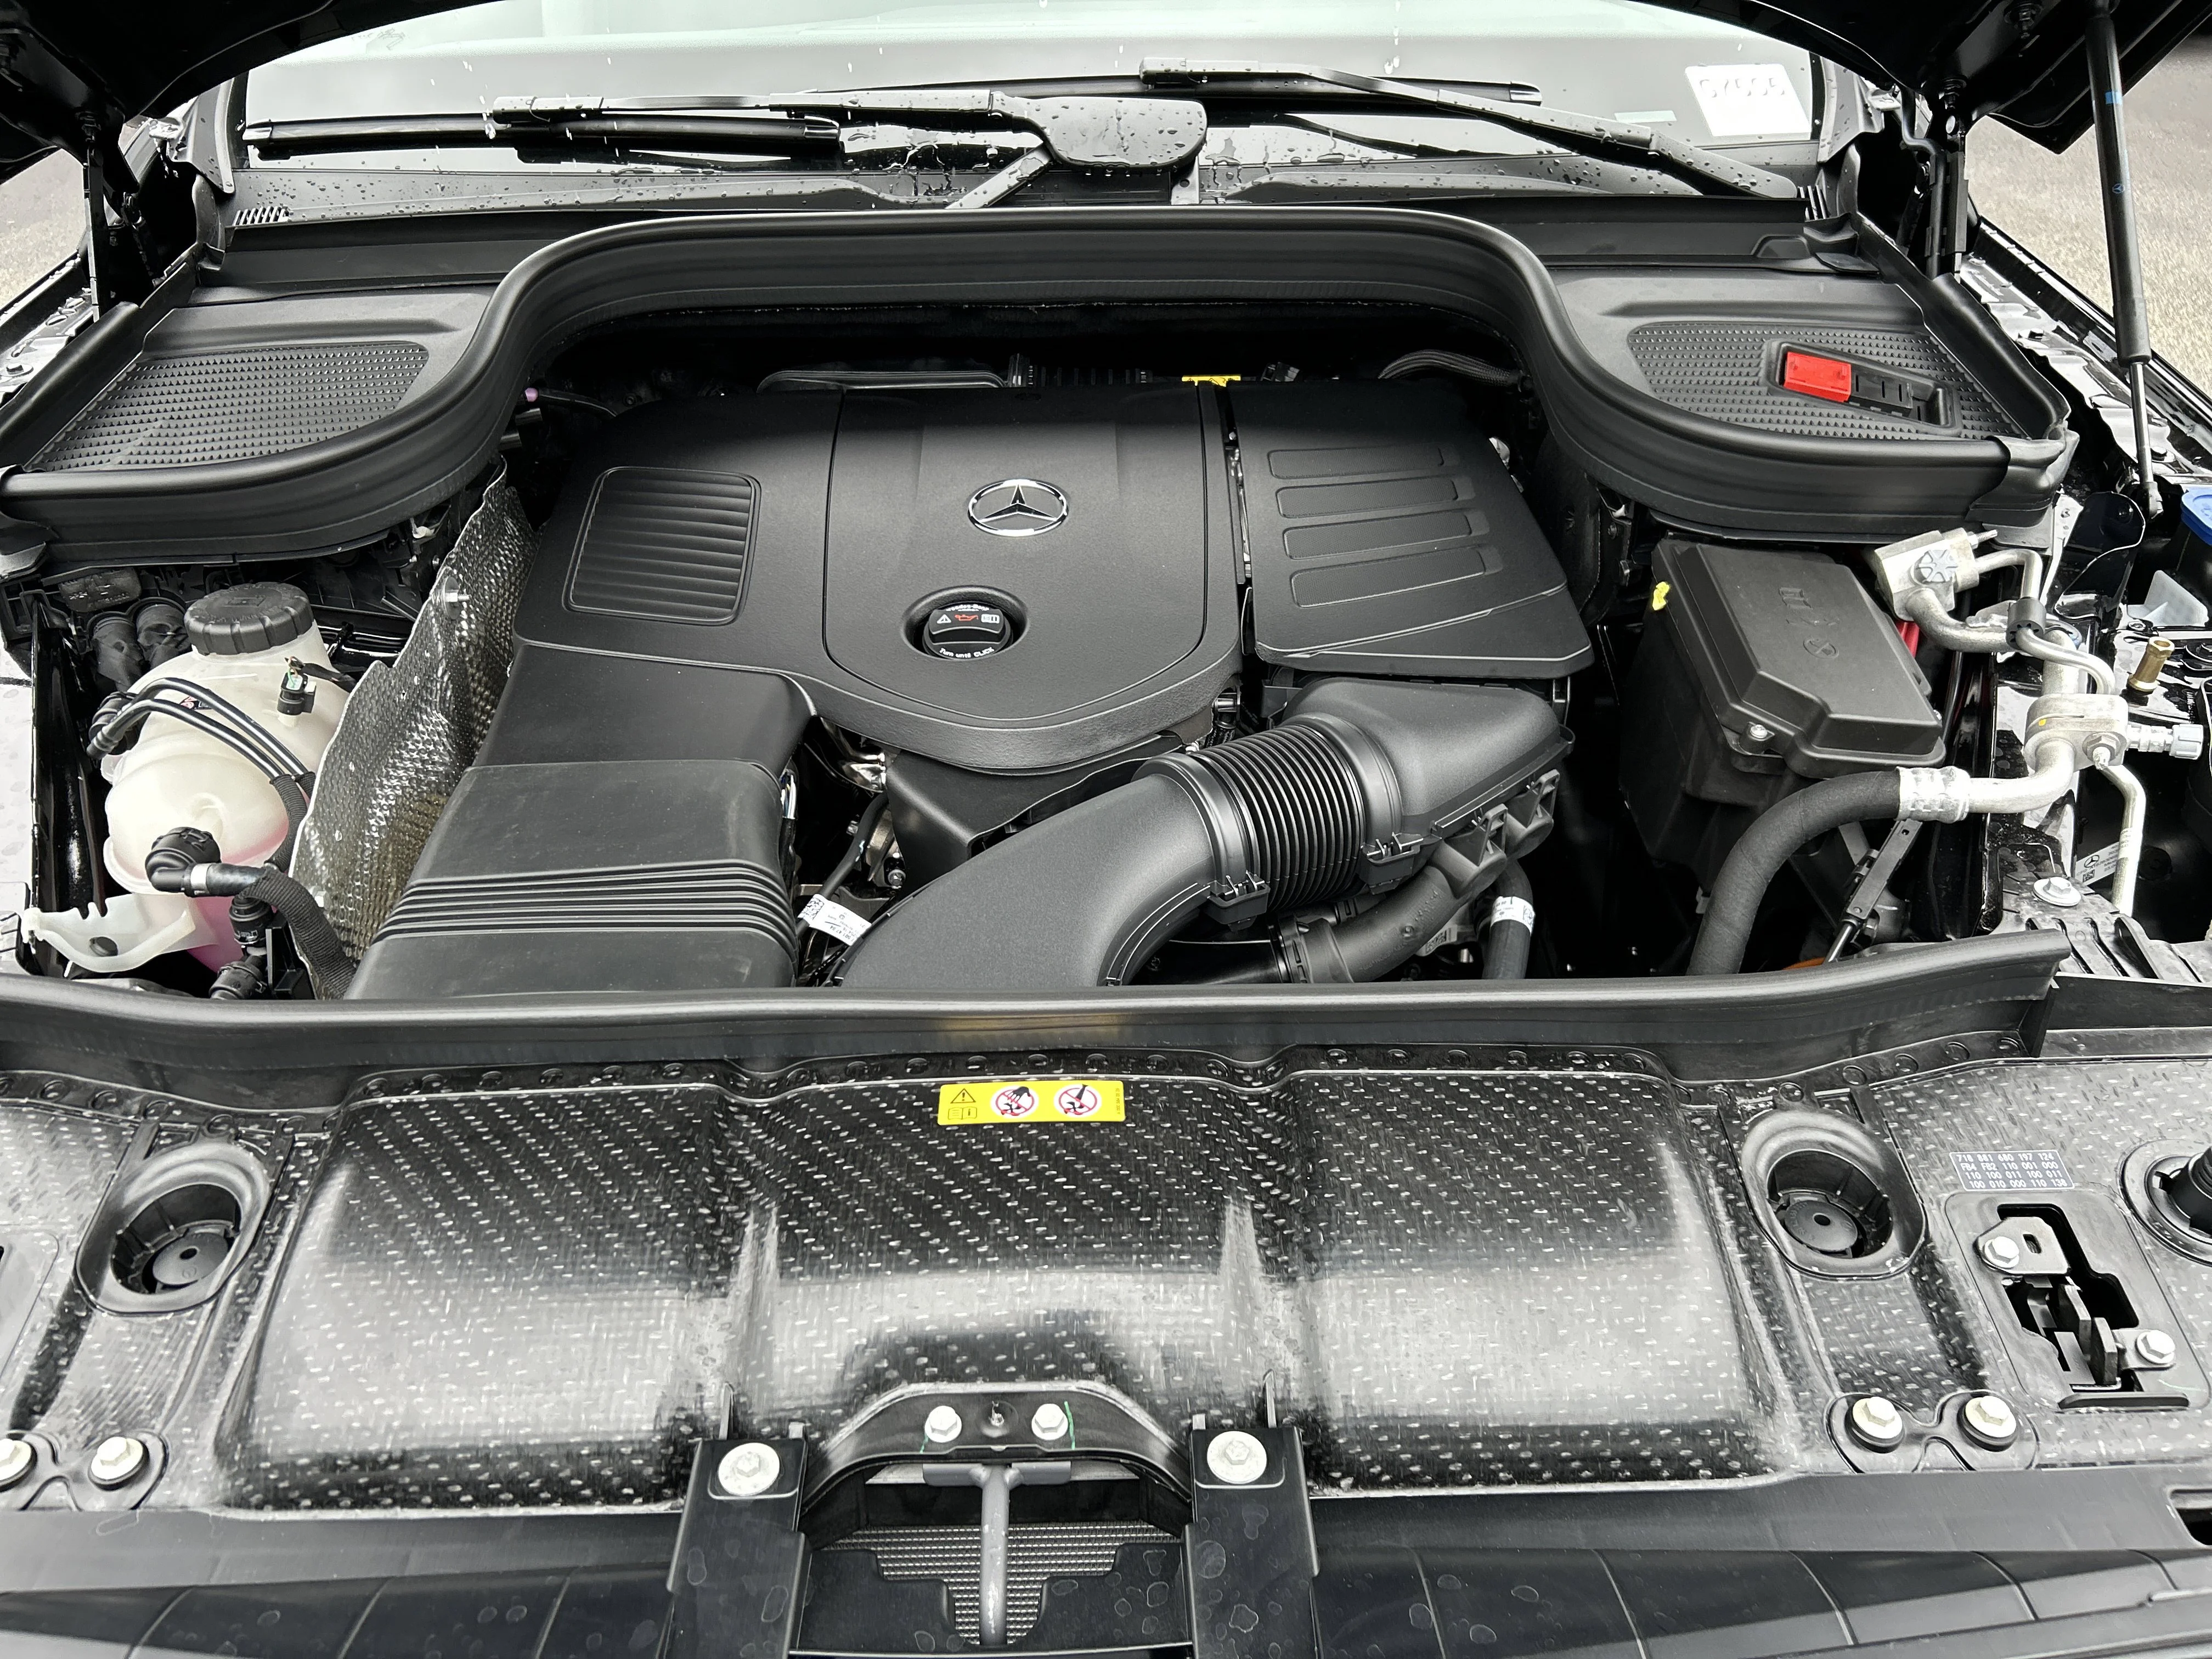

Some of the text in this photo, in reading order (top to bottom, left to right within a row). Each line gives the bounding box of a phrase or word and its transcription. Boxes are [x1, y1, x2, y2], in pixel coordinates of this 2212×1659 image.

[939, 648, 954, 657] Turn
[973, 647, 995, 657] CLICK
[2022, 1161, 2038, 1170] 001
[2006, 1171, 2022, 1179] 011
[2027, 1170, 2043, 1178] 100
[1969, 1181, 1985, 1189] 100
[1989, 1180, 2006, 1188] 010
[2010, 1180, 2027, 1188] 000
[2031, 1179, 2047, 1187] 110
